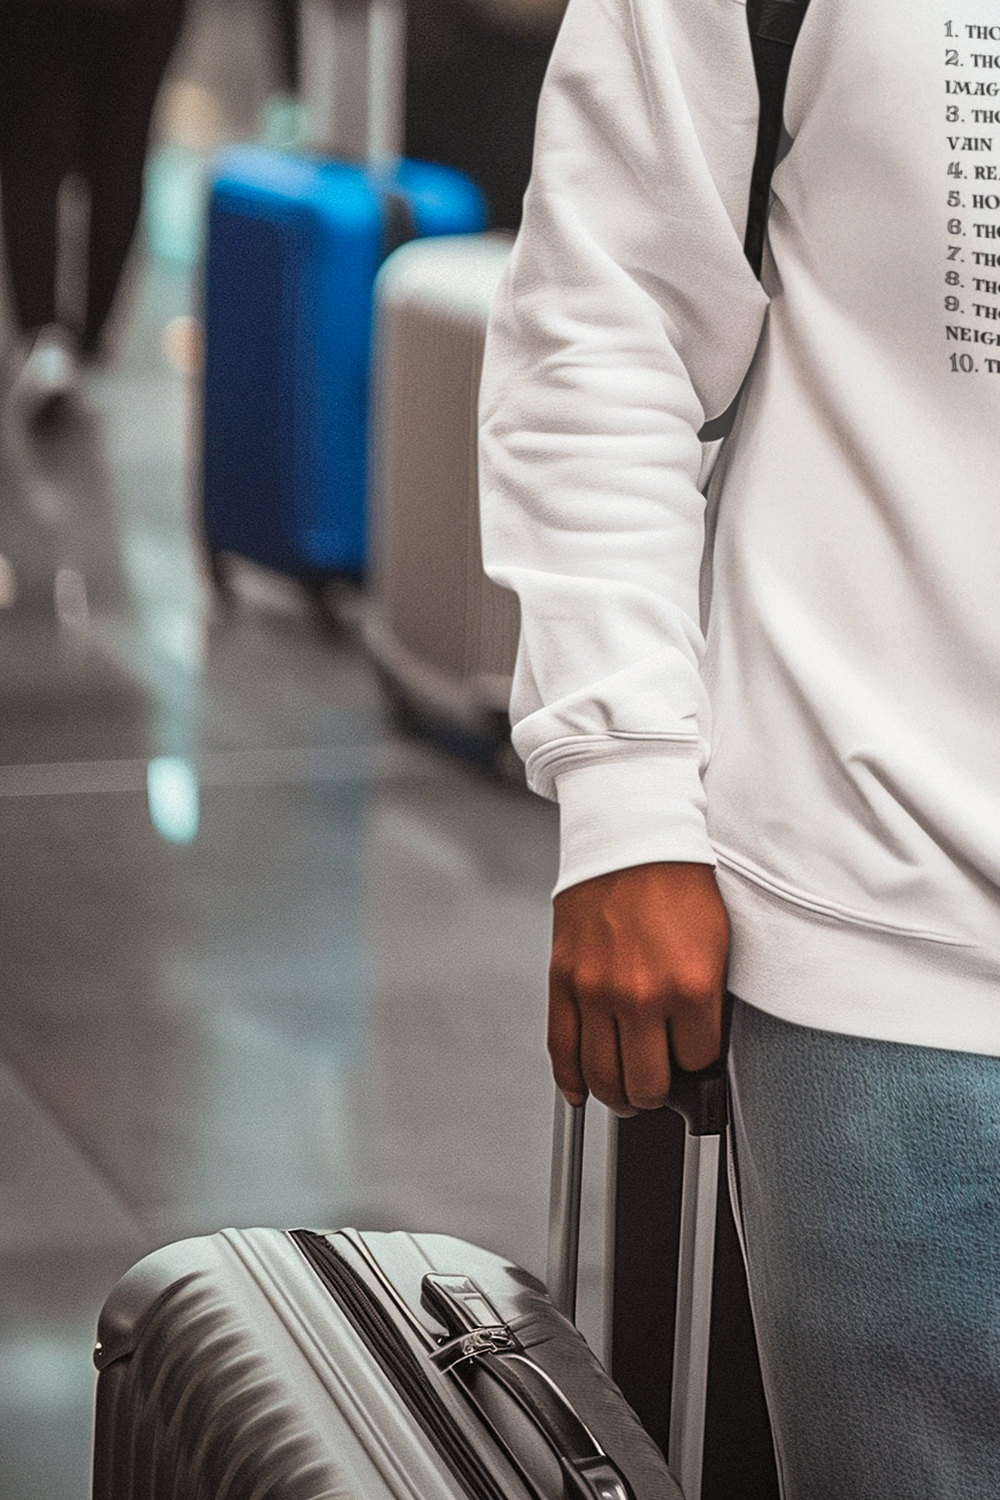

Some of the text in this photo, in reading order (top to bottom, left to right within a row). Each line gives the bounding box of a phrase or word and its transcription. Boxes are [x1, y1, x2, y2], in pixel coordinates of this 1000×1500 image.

[943, 19, 959, 38] 1.
[944, 48, 964, 67] 2.
[945, 104, 965, 123] 3.
[946, 136, 993, 152] VAIN
[946, 161, 968, 180] 4.
[946, 190, 966, 208] 5.
[947, 218, 967, 237] 6.
[946, 244, 965, 263] 7.
[944, 270, 965, 289] 8.
[944, 295, 965, 314] 9.
[948, 352, 979, 374] 10.
